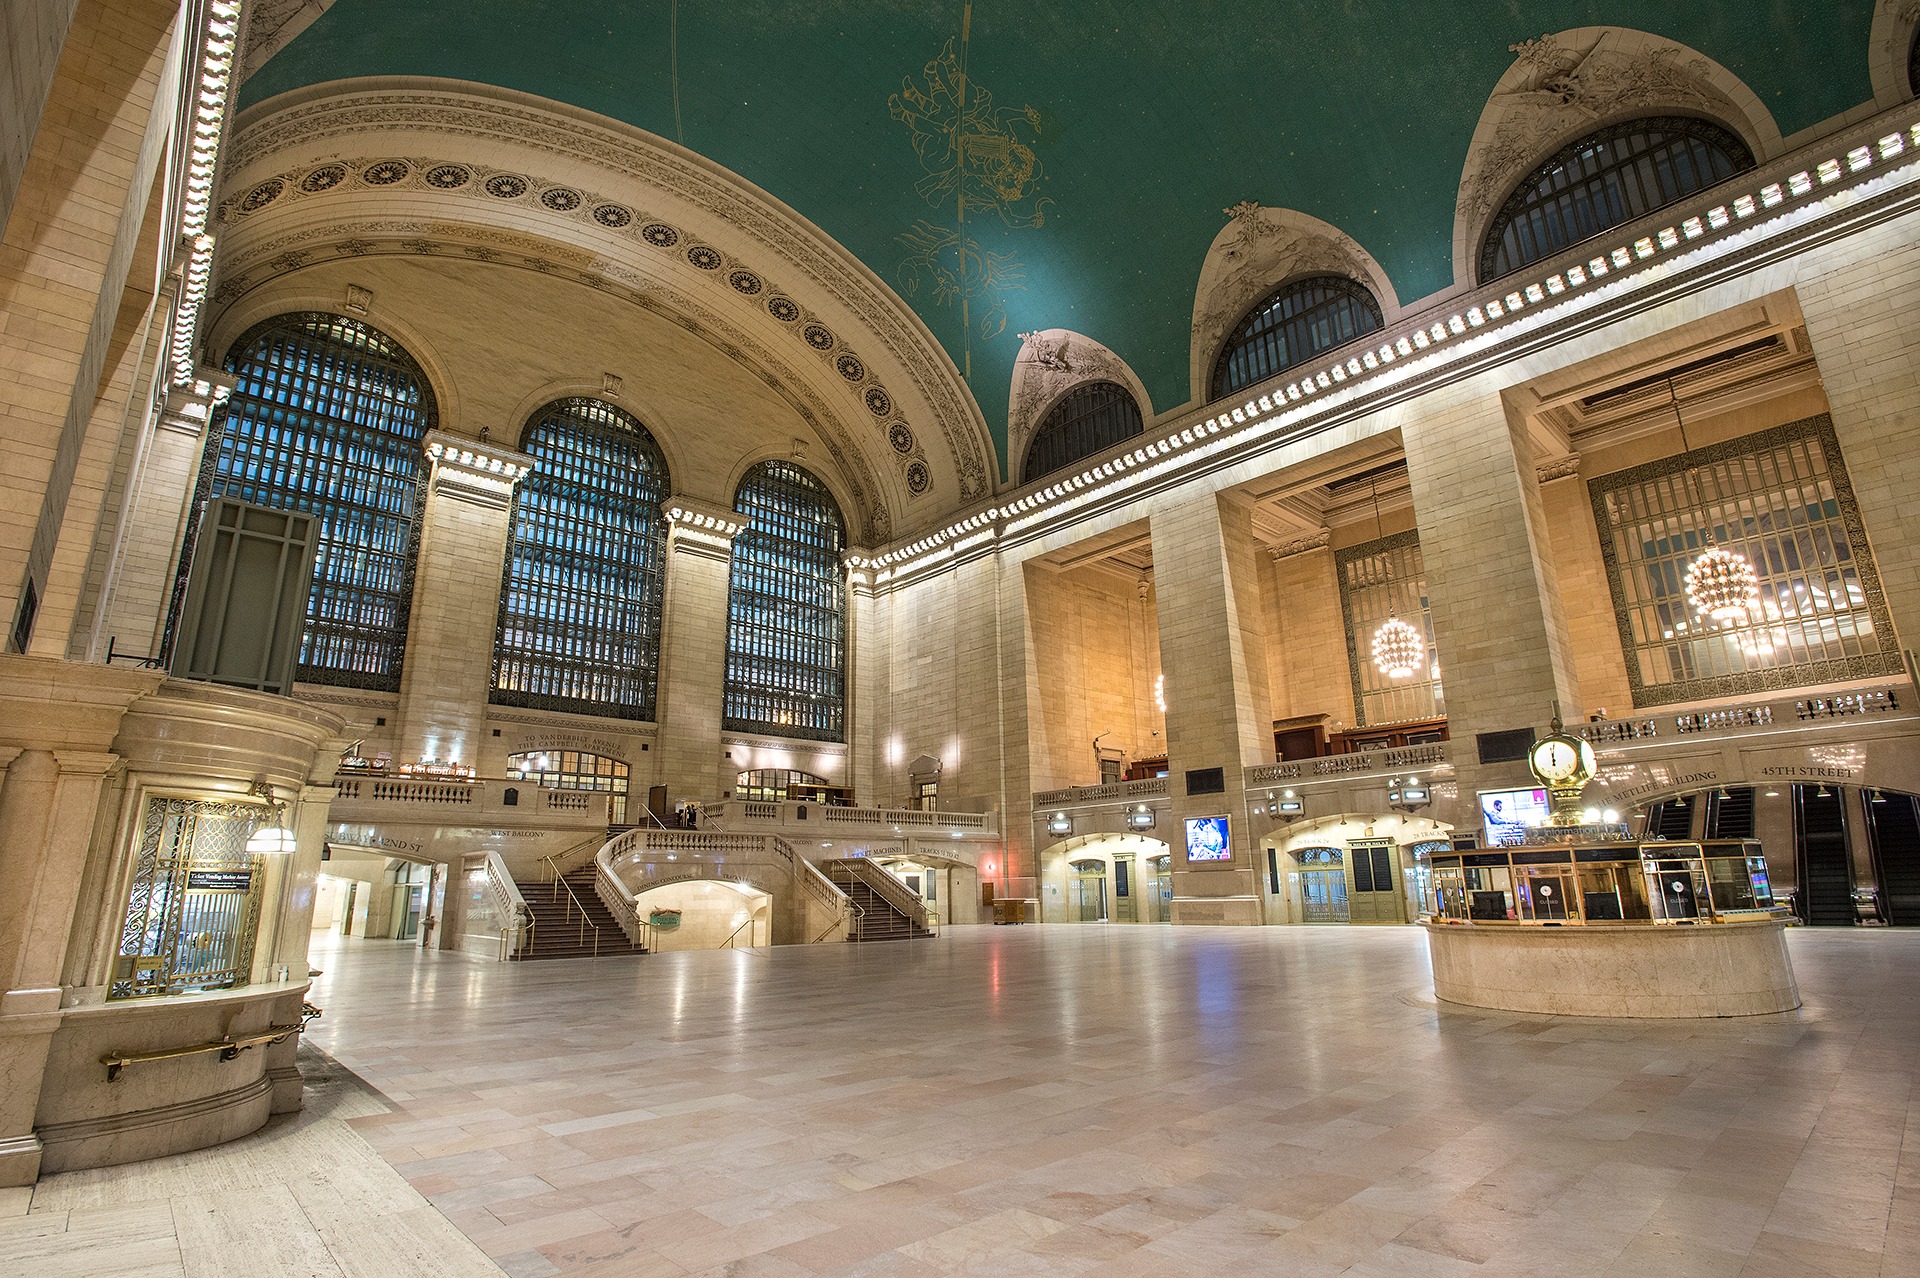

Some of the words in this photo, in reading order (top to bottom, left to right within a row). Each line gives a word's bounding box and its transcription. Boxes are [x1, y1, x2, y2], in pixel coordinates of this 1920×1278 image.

[540, 734, 589, 743] VANDERBILT
[592, 738, 622, 750] AVENUE
[517, 742, 535, 750] THE
[538, 740, 579, 748] CAMPBELL
[582, 743, 627, 759] APARTMENT
[1761, 766, 1796, 776] 45TH
[1799, 766, 1855, 778] STREET
[1612, 781, 1660, 802] METLIFE
[1662, 770, 1717, 788] BUILDING
[511, 830, 546, 838] BALCONY
[1545, 825, 1597, 837] Information
[378, 837, 408, 850] 42ND
[408, 842, 424, 853] ST
[873, 846, 902, 855] MACHINES
[919, 847, 940, 855] TRACKS
[637, 880, 660, 891] DINING
[660, 873, 693, 884] CONCOURSE
